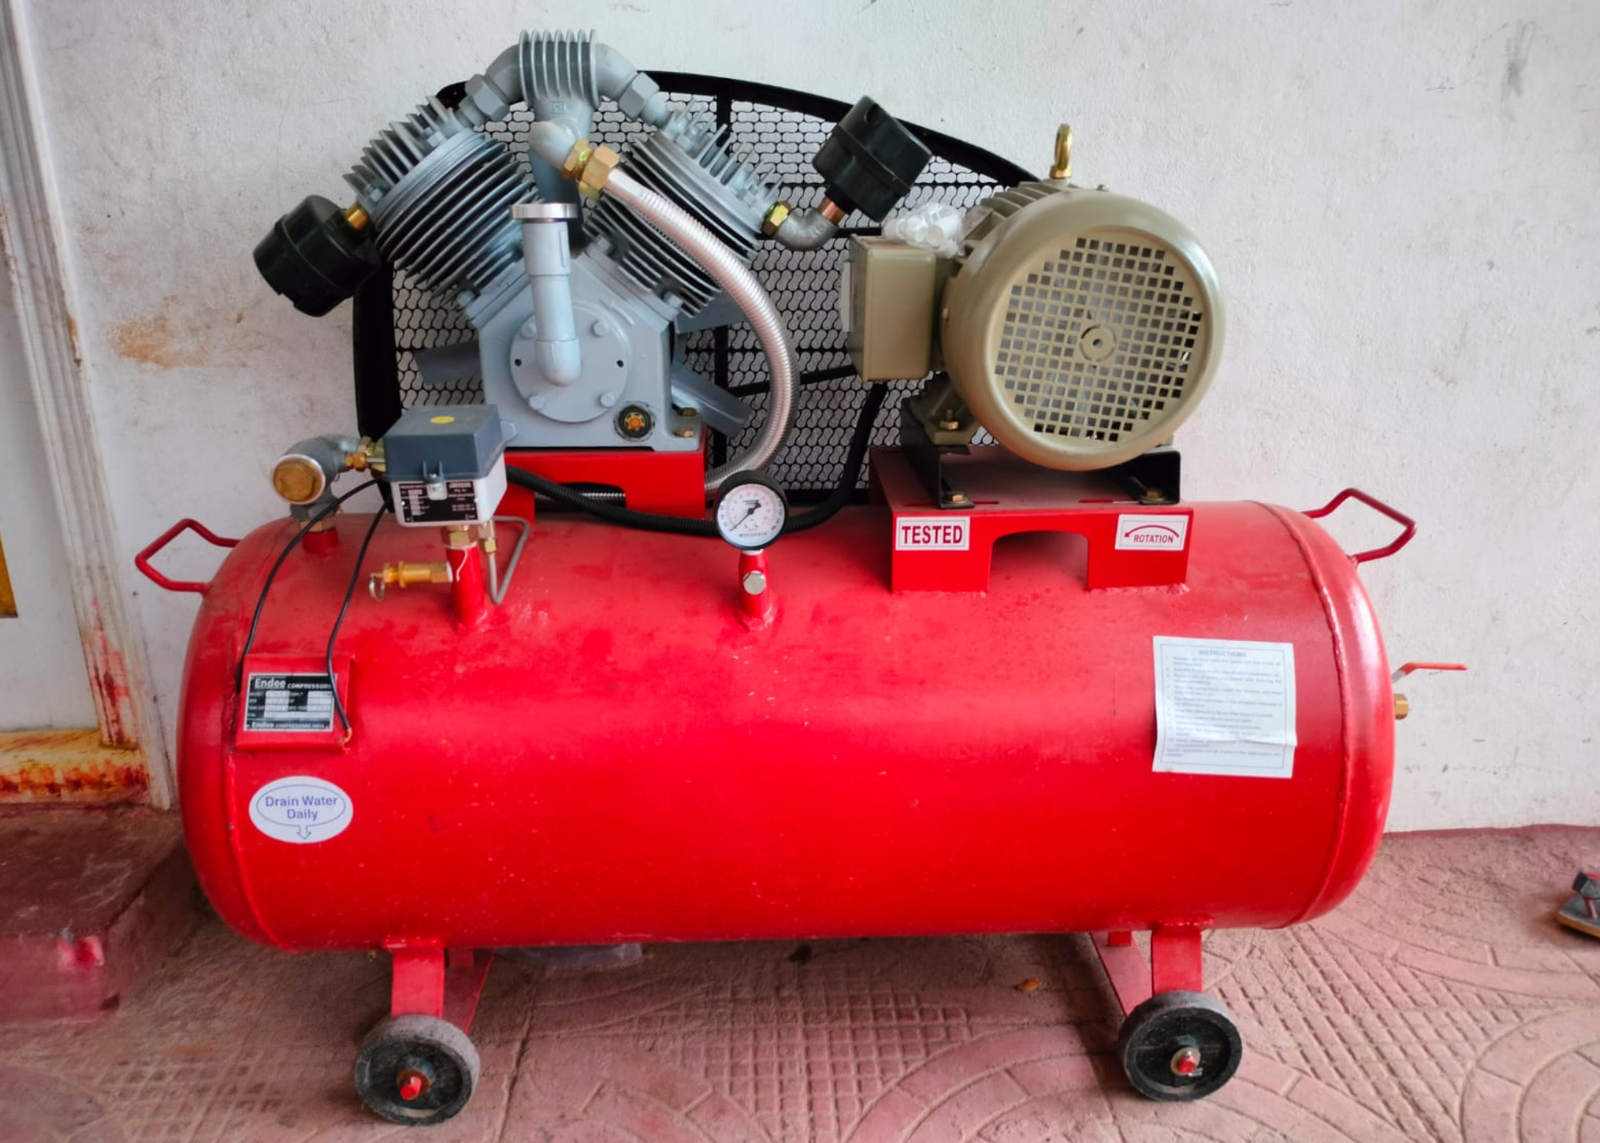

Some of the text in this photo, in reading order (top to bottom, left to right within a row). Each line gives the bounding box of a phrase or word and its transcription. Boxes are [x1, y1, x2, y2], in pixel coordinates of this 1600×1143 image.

[901, 525, 962, 544] TESTED
[1133, 534, 1174, 543] ROTATION
[254, 677, 286, 689] Endee
[265, 795, 338, 807] Drain Water
[287, 809, 318, 821] Daily
